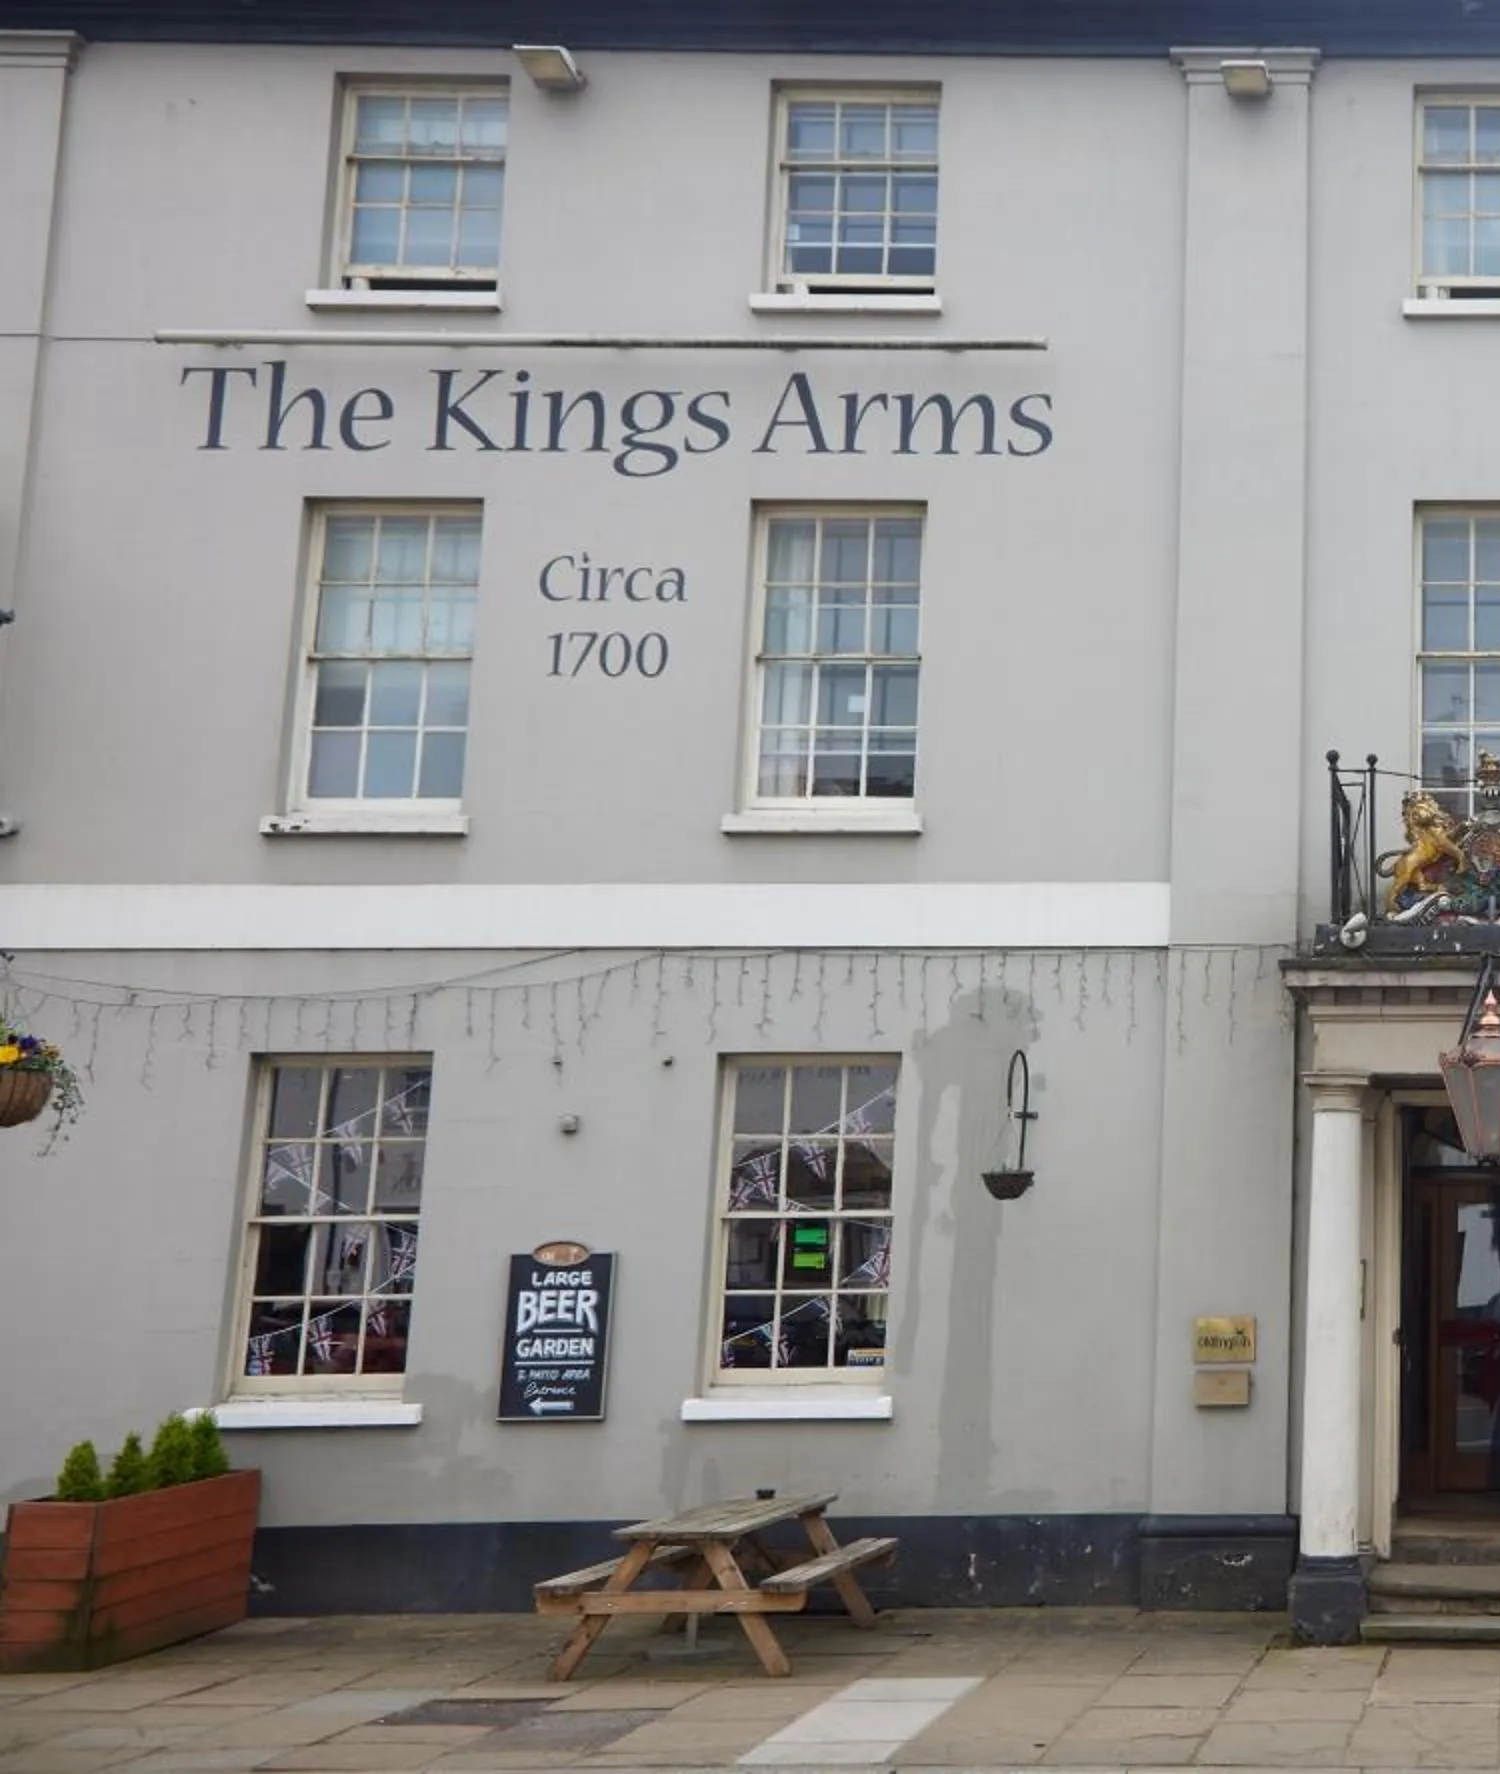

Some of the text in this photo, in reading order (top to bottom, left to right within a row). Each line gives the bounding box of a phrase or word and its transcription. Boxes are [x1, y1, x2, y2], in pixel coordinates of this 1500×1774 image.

[180, 360, 1055, 479] The Kings Arms
[538, 552, 687, 604] Circa
[545, 631, 670, 679] 1700
[531, 1270, 593, 1287] LARGE
[515, 1289, 600, 1336] BEER
[515, 1337, 595, 1358] GARDEN
